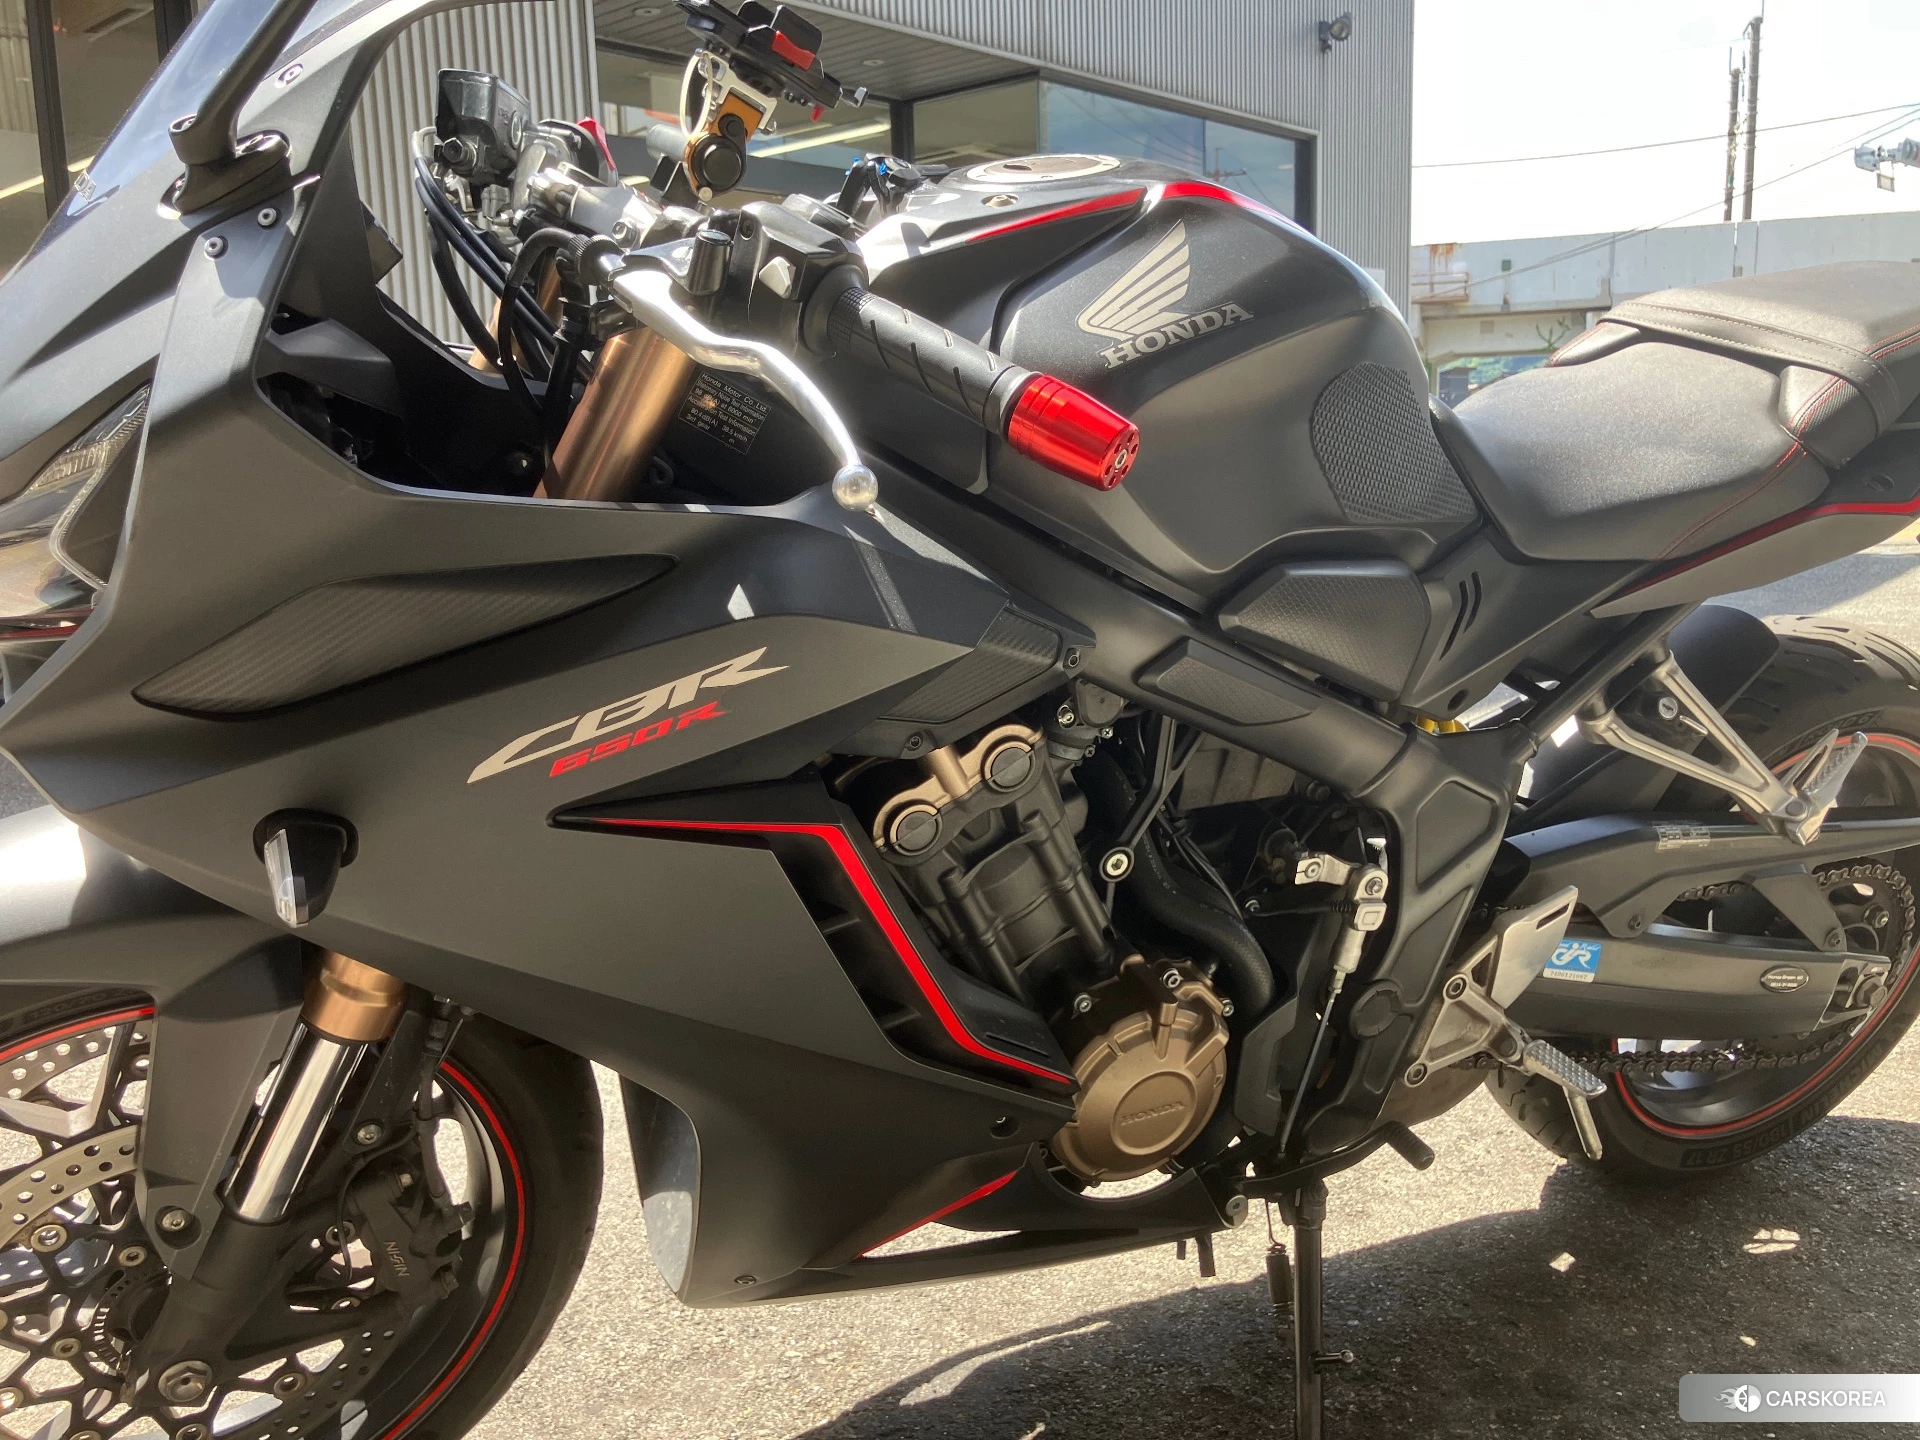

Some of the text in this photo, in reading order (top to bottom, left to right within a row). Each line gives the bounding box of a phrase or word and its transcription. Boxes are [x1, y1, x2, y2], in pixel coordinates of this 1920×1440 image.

[1100, 303, 1254, 369] HONDA
[702, 373, 722, 388] Honda
[724, 385, 742, 399] Motor
[467, 646, 790, 784] CBR
[548, 700, 726, 778] 650R
[1121, 1101, 1186, 1126] HONDA
